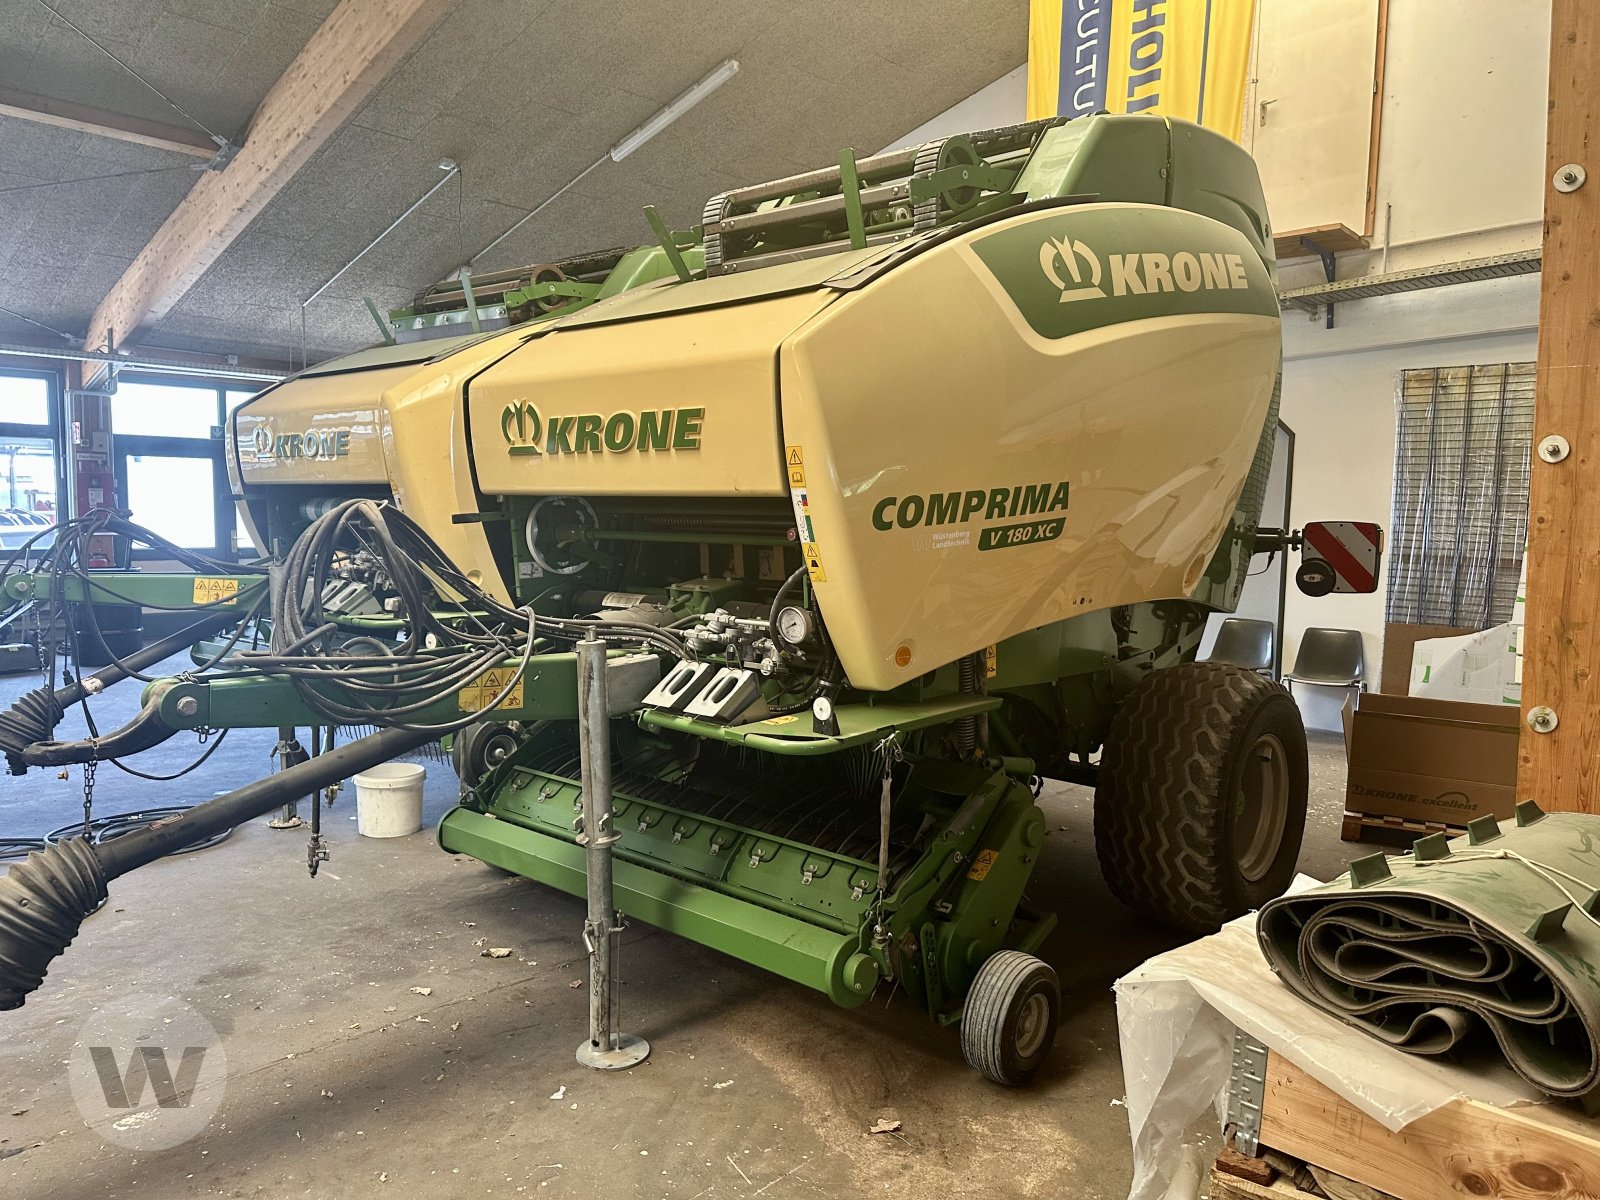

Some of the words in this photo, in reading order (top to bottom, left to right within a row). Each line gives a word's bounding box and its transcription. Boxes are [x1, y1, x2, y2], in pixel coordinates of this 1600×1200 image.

[1073, 0, 1099, 111] ULTU
[1108, 251, 1249, 297] KRONE
[275, 427, 351, 458] KRONE
[546, 407, 706, 454] KRONE
[872, 481, 1070, 532] COMPRIMA
[932, 530, 970, 541] Wüstenberg
[932, 538, 970, 549] Landtechnik
[990, 530, 1003, 546] V
[1007, 526, 1032, 543] 180
[1034, 522, 1057, 540] XC
[1364, 786, 1418, 803] KRONE
[1422, 797, 1479, 811] excellent
